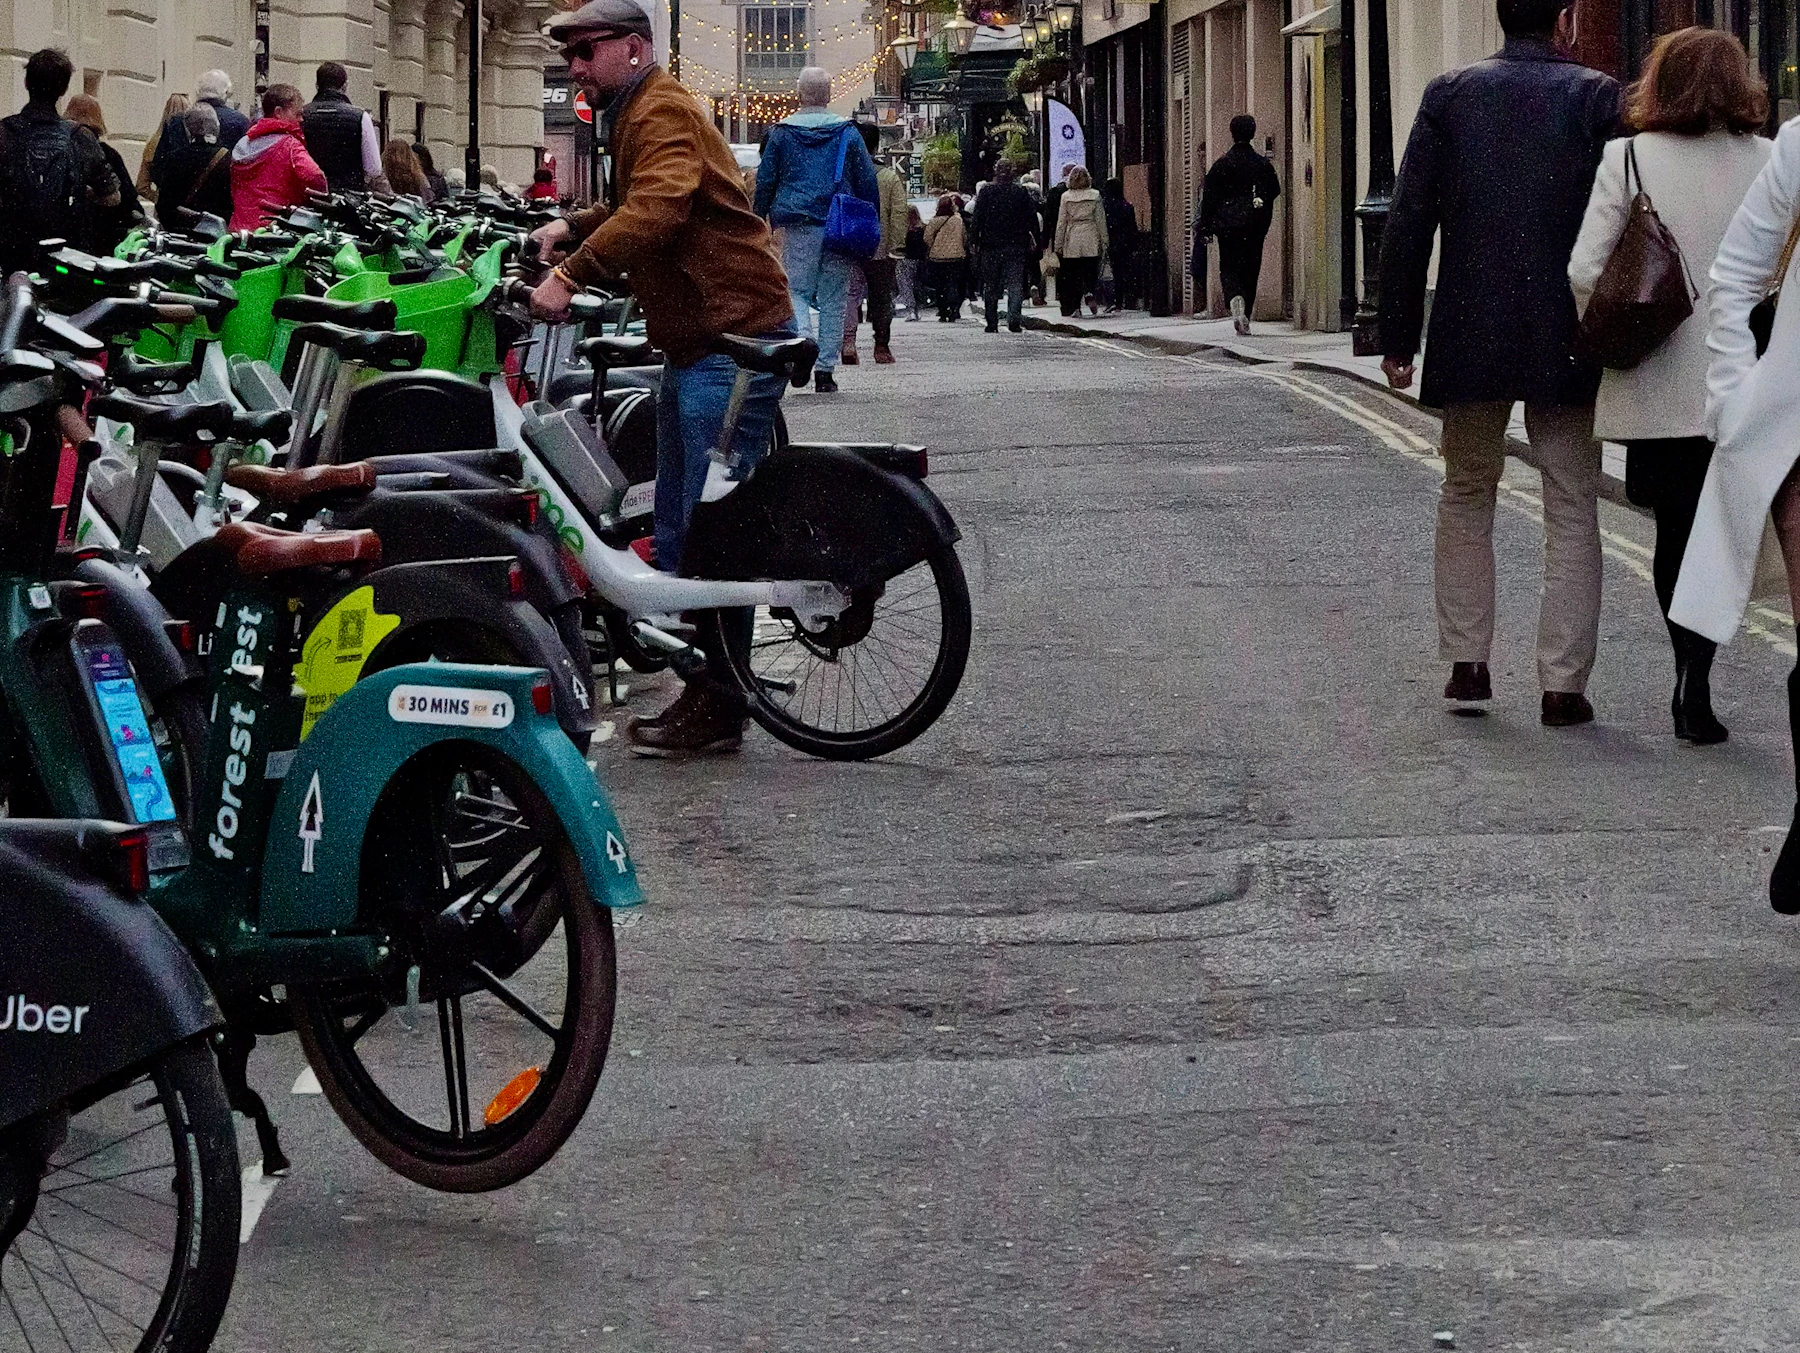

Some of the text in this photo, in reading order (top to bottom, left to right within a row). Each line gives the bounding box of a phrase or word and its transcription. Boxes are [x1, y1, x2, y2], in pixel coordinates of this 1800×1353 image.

[408, 696, 428, 713] 30
[430, 697, 470, 716] MINS
[491, 702, 507, 718] £1
[208, 701, 257, 861] forest
